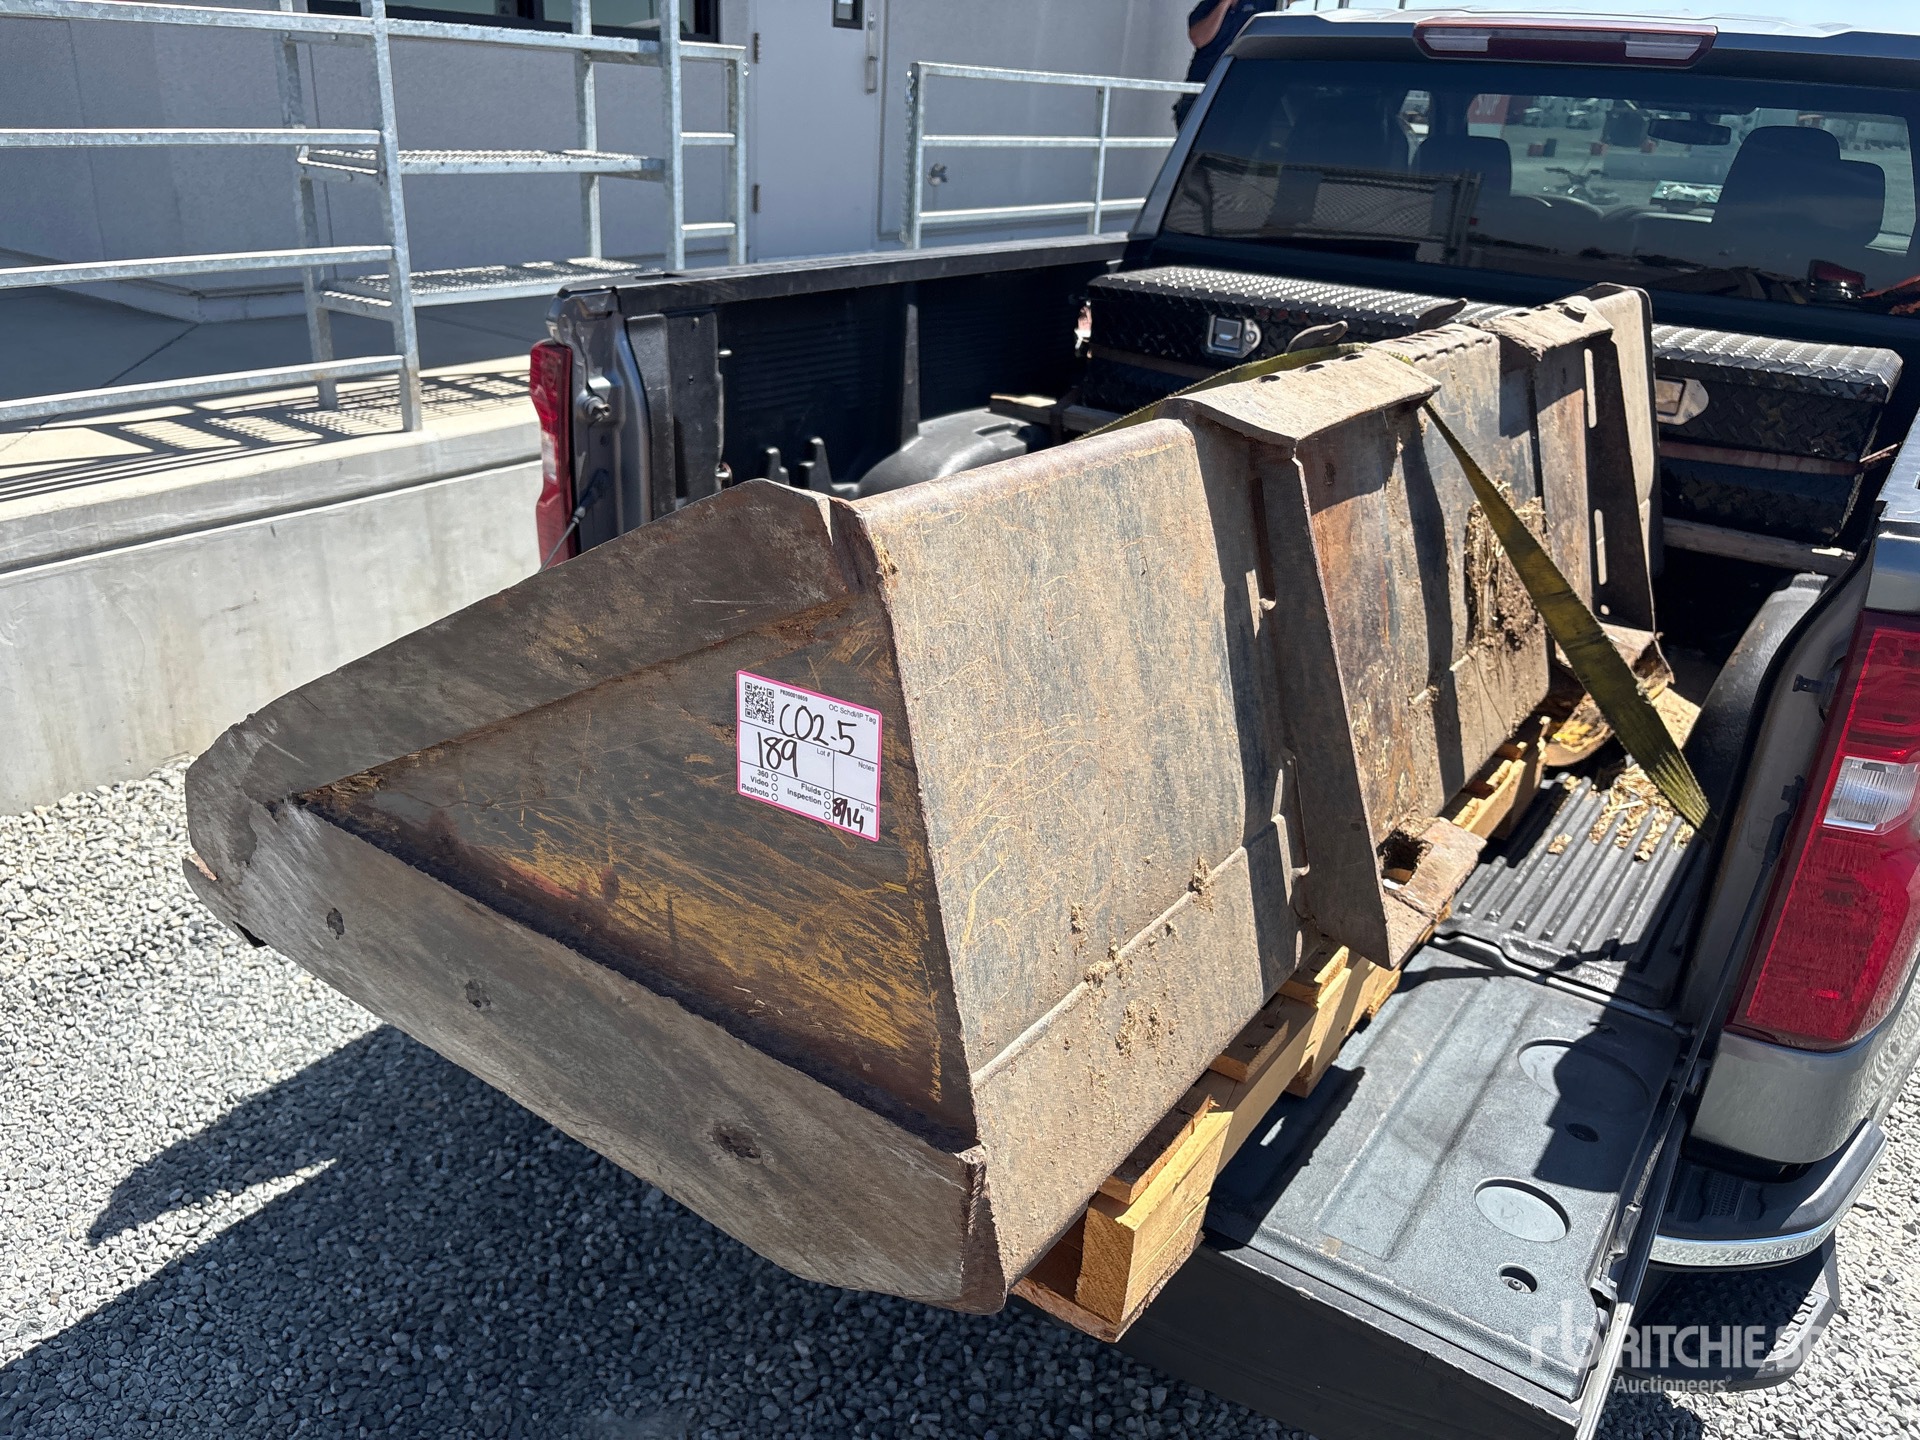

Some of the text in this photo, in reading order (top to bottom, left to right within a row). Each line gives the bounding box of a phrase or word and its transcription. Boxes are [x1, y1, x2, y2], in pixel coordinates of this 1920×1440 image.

[828, 703, 838, 713] OC
[865, 714, 877, 725] Tag
[757, 732, 798, 778] 189
[816, 748, 826, 757] Lot
[858, 761, 875, 773] Notes
[757, 769, 769, 779] 360
[750, 776, 769, 788] Video
[741, 783, 769, 798] Rephoto
[801, 783, 821, 796] Fluids
[787, 788, 822, 806] Inspection
[860, 803, 874, 813] Date
